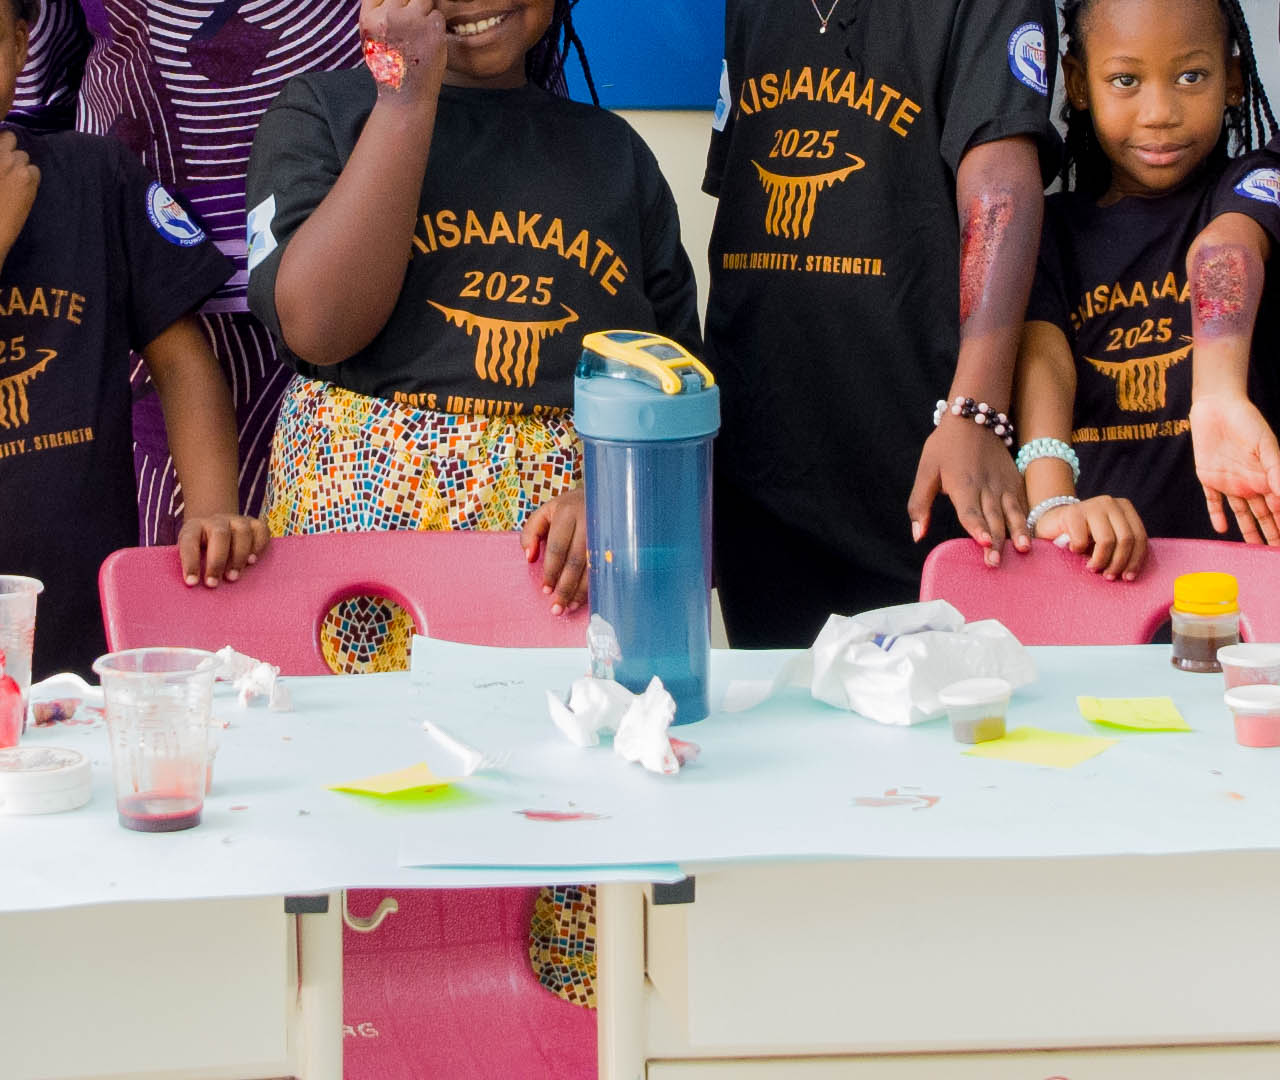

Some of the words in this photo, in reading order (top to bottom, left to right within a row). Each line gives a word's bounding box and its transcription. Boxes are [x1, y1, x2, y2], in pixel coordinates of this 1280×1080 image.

[769, 128, 840, 159] 2025
[410, 209, 629, 297] ISAAKAATE
[806, 255, 887, 276] STRENGTH.
[459, 270, 555, 306] 2025
[1103, 317, 1173, 352] 2025
